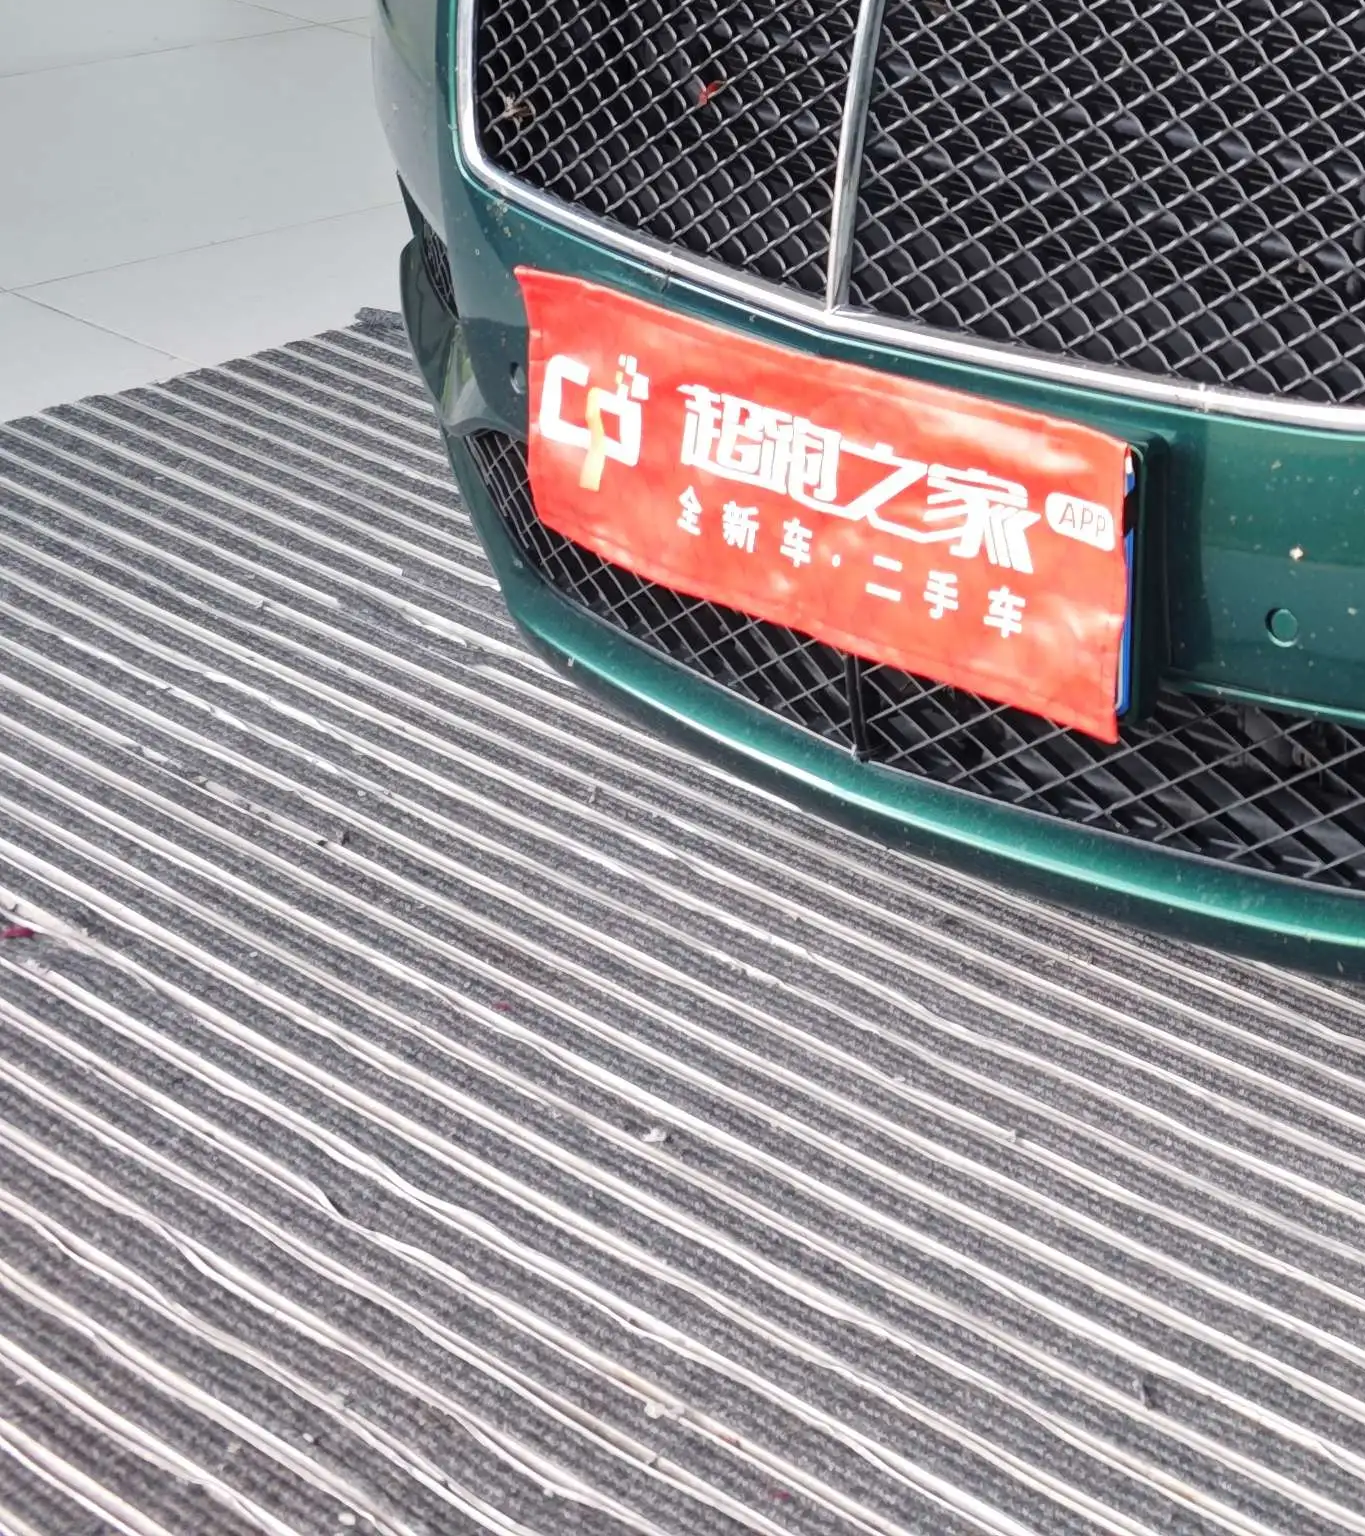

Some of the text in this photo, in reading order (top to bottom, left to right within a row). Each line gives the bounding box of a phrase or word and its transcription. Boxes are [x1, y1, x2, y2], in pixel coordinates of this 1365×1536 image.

[677, 384, 1107, 574] 超跑之家 APP
